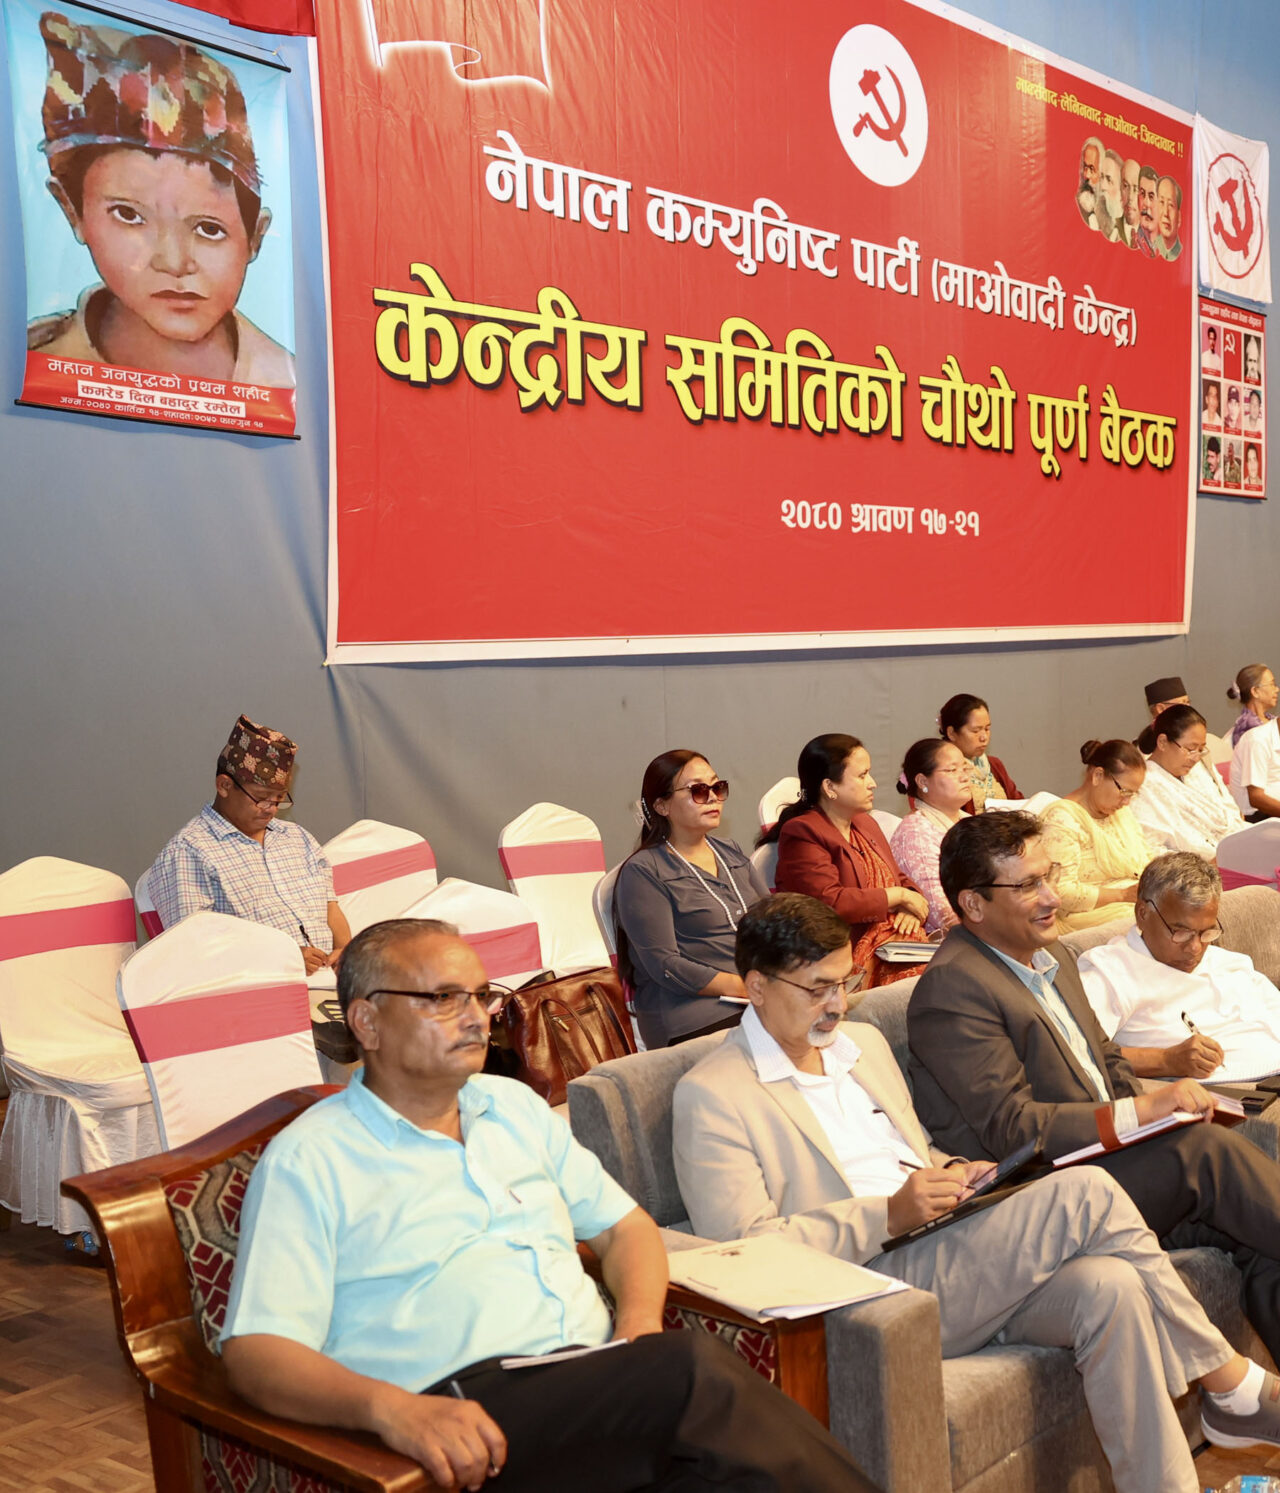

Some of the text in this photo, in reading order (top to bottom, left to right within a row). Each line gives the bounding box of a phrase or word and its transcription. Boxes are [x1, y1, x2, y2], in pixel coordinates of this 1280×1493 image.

[483, 129, 1138, 347] नेपाल कम्युनिष्ट पार्टी (माओवादी केन्द्र)
[48, 358, 271, 402] महान जनयुद्धको प्रथम शहीद
[373, 262, 1177, 480] केन्द्रीय समितिको चौथो पूर्ण बैठक
[81, 384, 124, 399] कमरेड
[129, 389, 155, 404] दिल
[780, 499, 980, 537] २०८० श्रावण १७-२१
